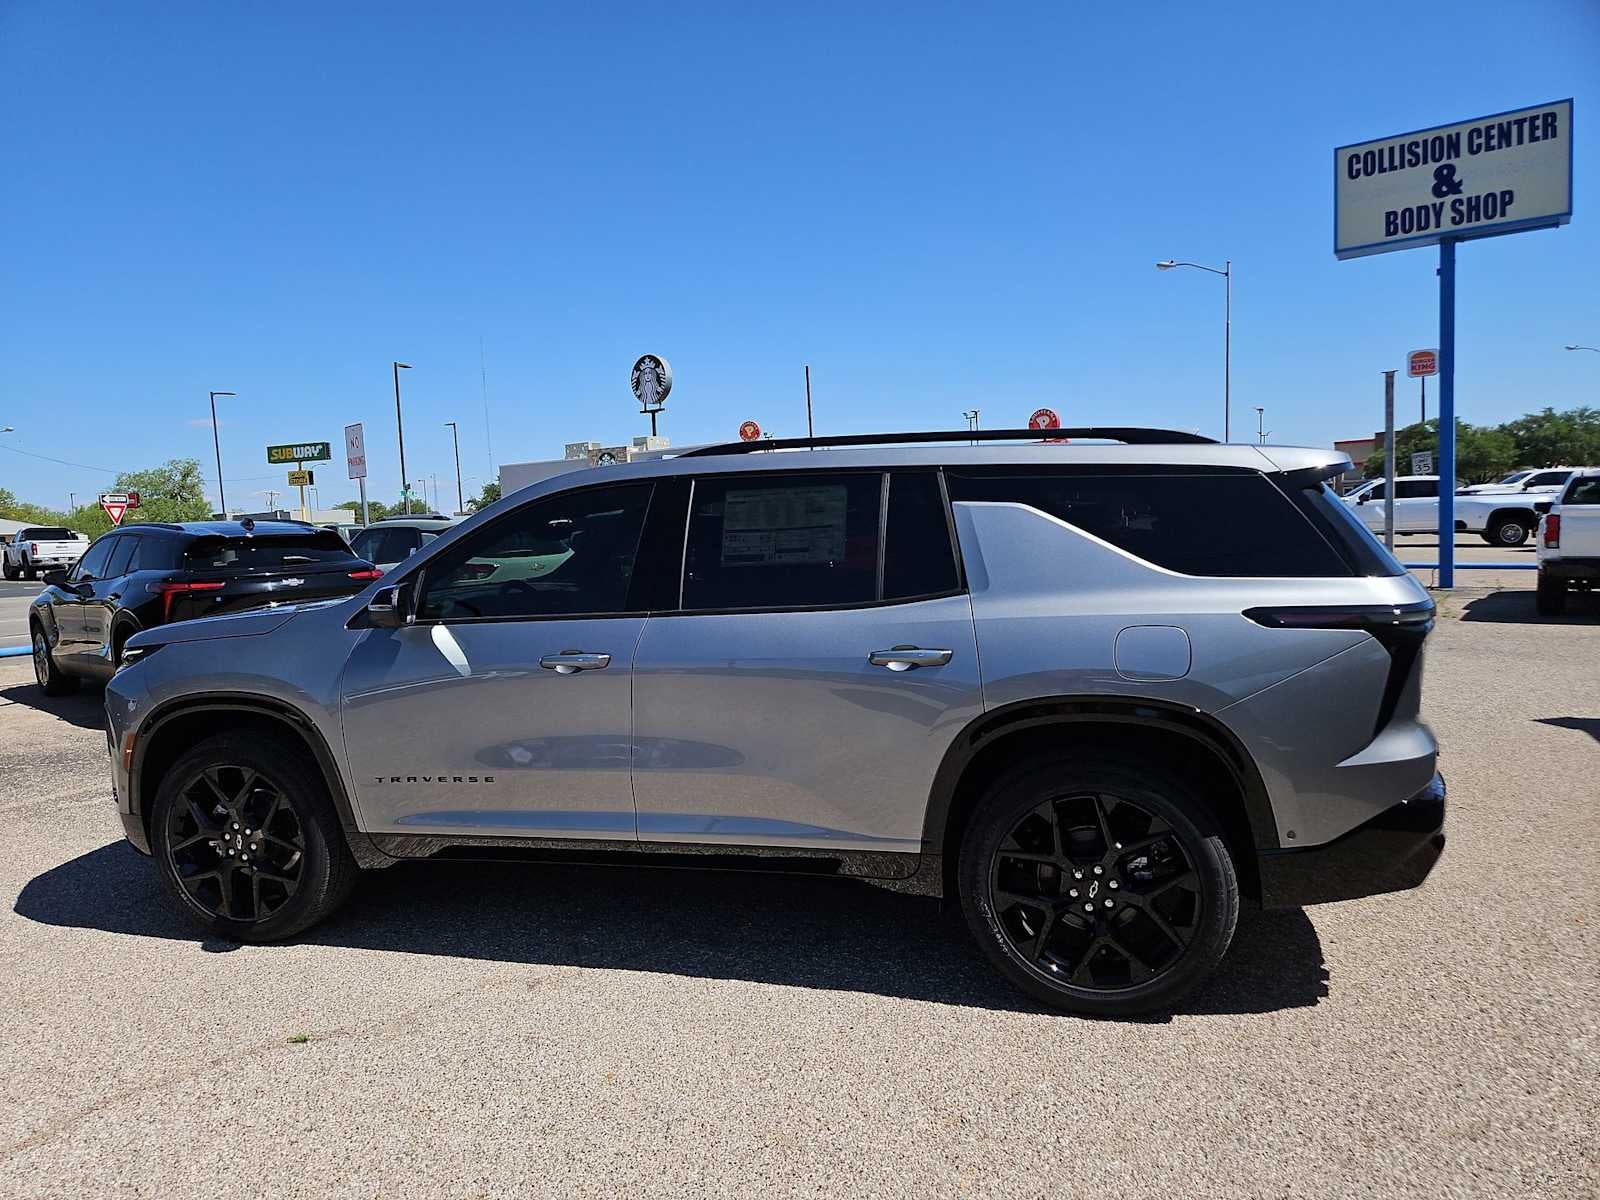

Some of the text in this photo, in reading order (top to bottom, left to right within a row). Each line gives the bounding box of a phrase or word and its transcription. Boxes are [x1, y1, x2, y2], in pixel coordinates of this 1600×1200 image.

[1347, 111, 1557, 180] COLLISION CENTER
[1432, 164, 1463, 198] &
[1385, 190, 1514, 237] BODY SHOP
[1411, 363, 1435, 371] KING
[350, 435, 360, 449] NO
[271, 445, 322, 461] SUBWAY
[1415, 463, 1431, 473] 35
[375, 776, 495, 784] TRAVERSE
